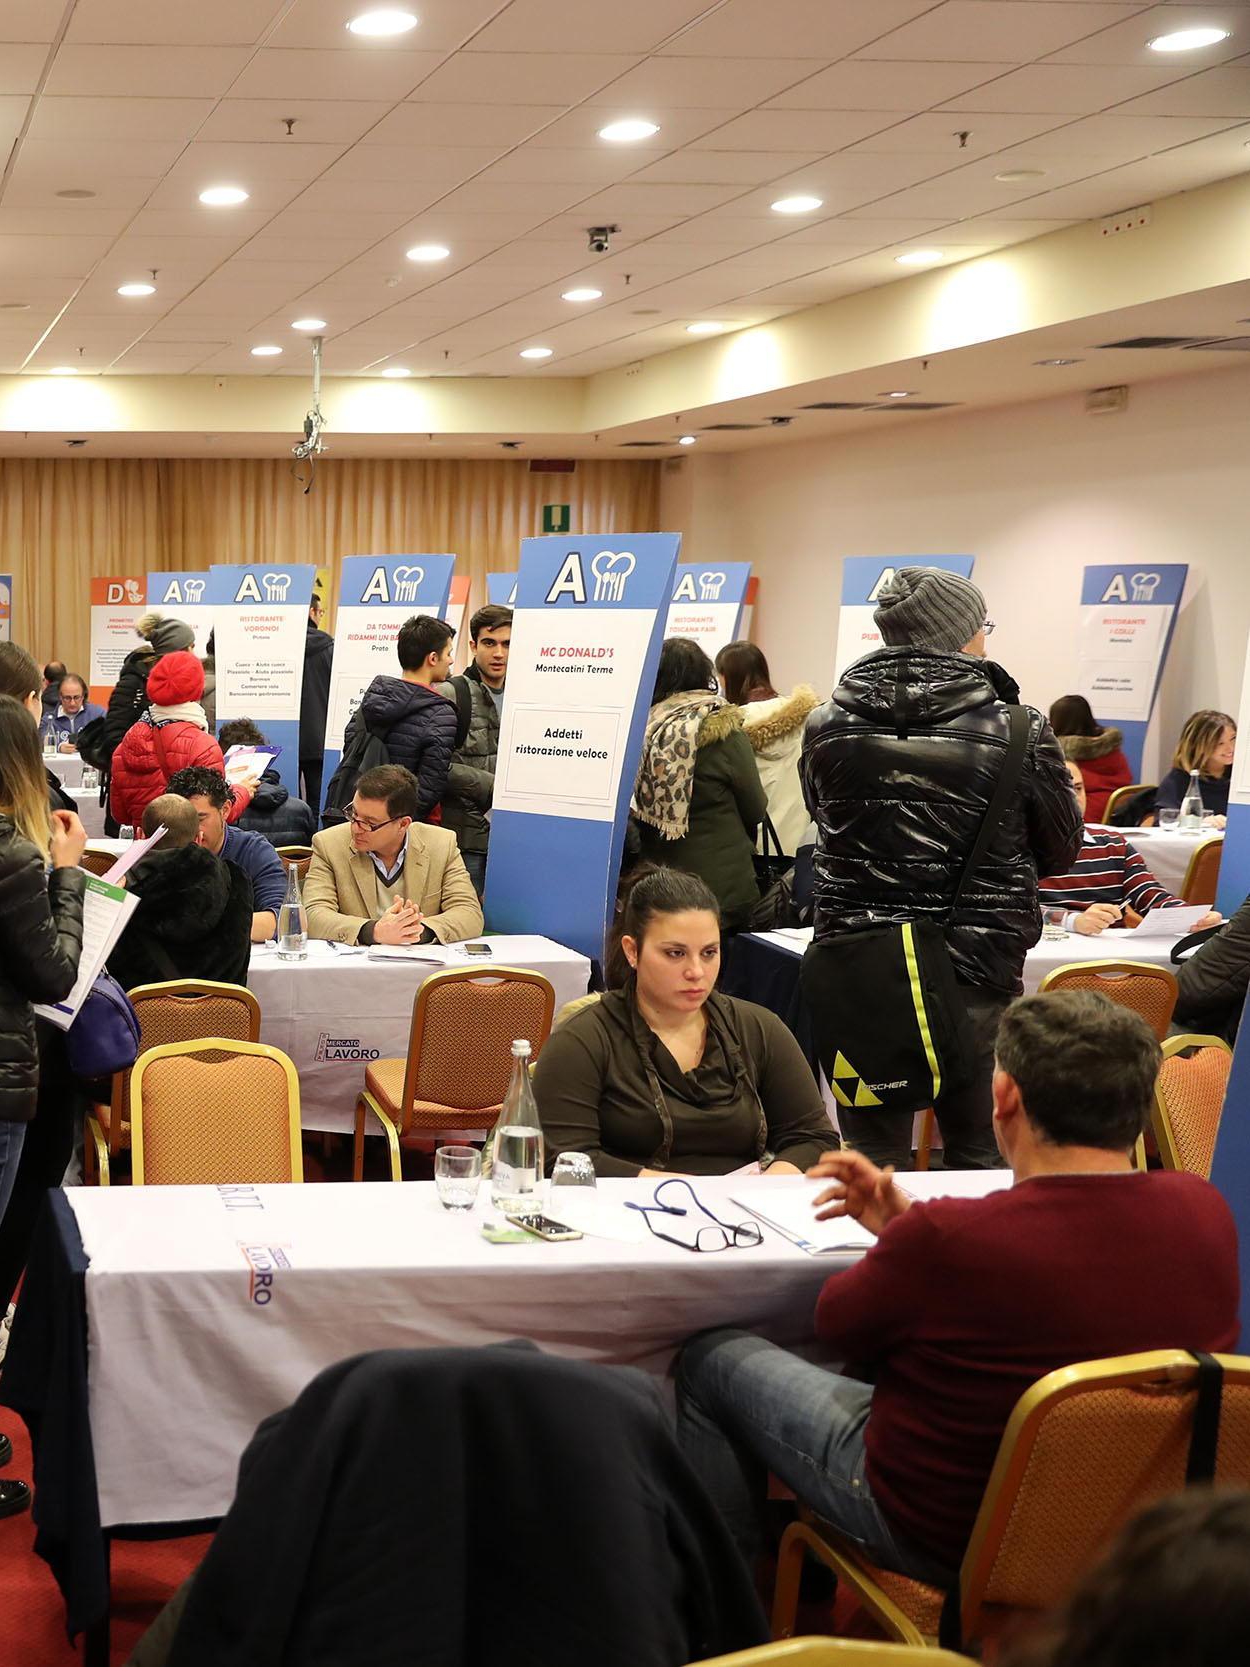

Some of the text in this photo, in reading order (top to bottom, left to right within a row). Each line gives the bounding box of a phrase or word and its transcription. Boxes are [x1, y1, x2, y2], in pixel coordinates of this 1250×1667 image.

[234, 574, 263, 602] A
[361, 566, 390, 603] A
[545, 552, 588, 604] A
[672, 572, 697, 601] A
[1101, 573, 1128, 602] A
[107, 583, 124, 603] D
[163, 580, 183, 603] A
[540, 646, 614, 658] MC DONALD'S
[535, 664, 614, 674] Montecatini Terme
[544, 727, 583, 740] Addetti
[515, 744, 608, 760] ristorazione veloce
[326, 1049, 380, 1059] LAVORO
